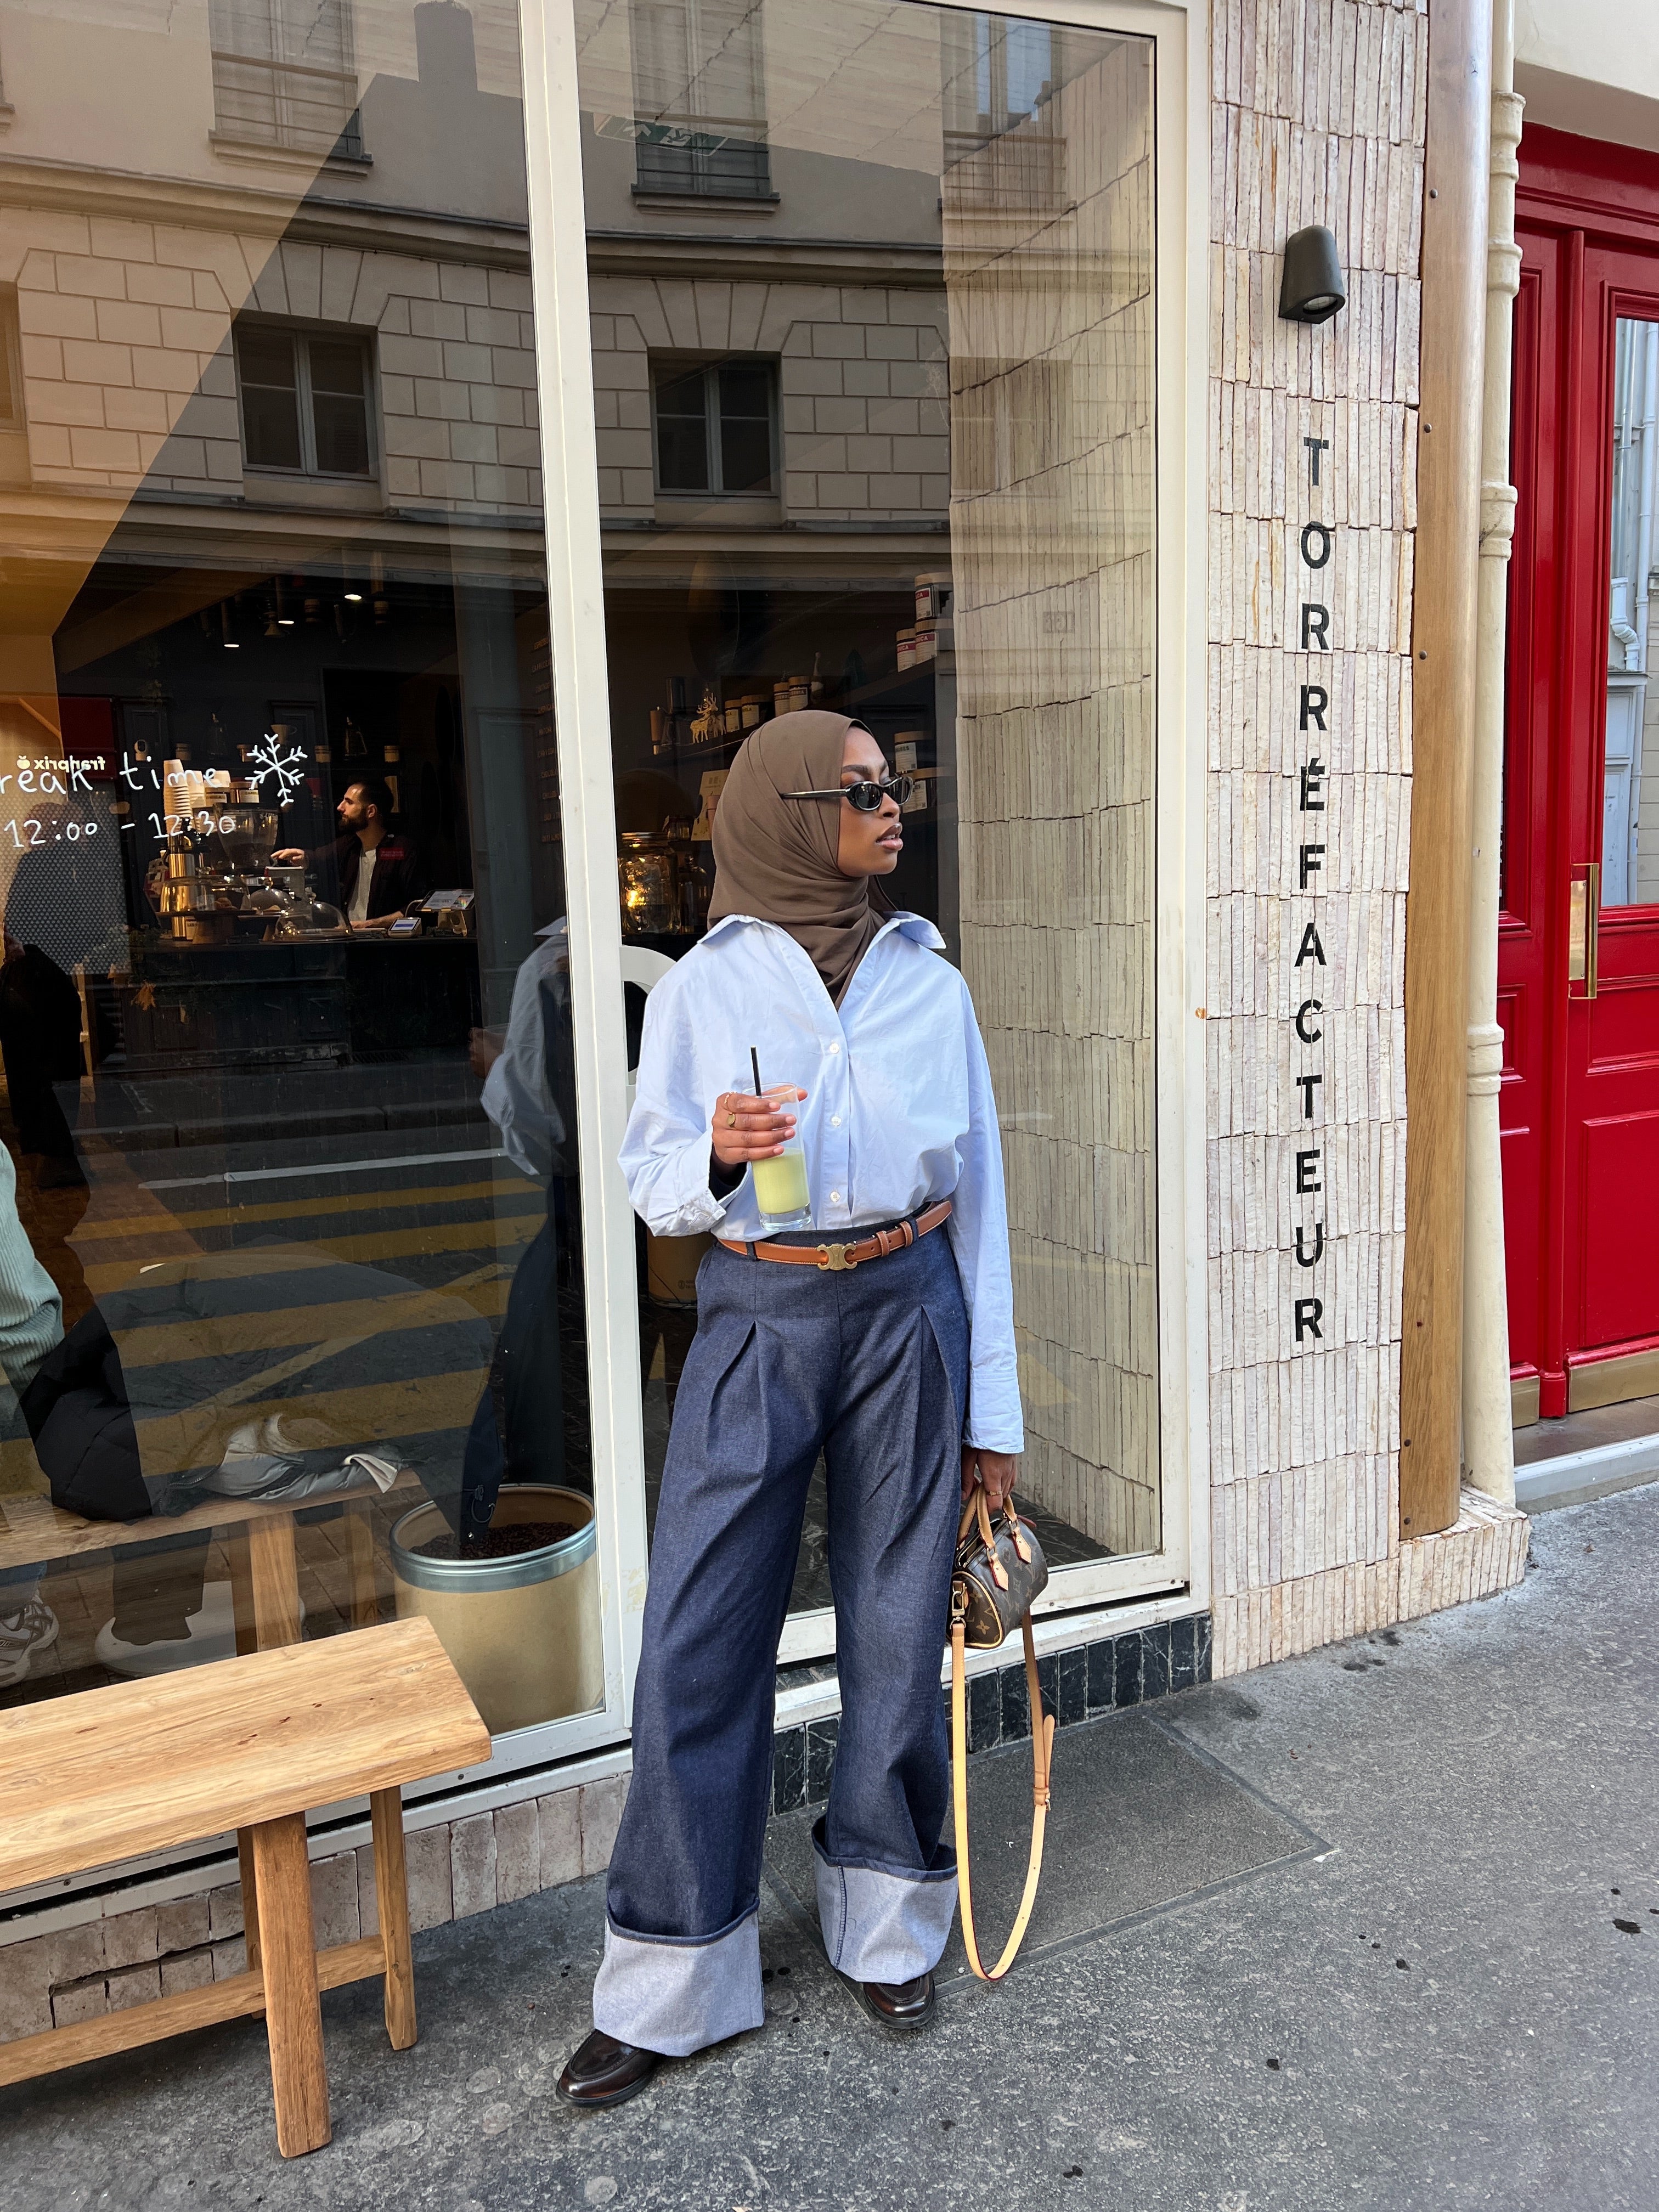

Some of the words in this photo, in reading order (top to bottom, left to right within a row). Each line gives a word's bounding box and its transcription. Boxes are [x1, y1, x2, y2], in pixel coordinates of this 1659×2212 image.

[119, 752, 222, 790] time
[4, 820, 98, 848] 12:00
[148, 810, 235, 839] 12:30
[1294, 437, 1330, 1342] TORRÉFACTEUR
